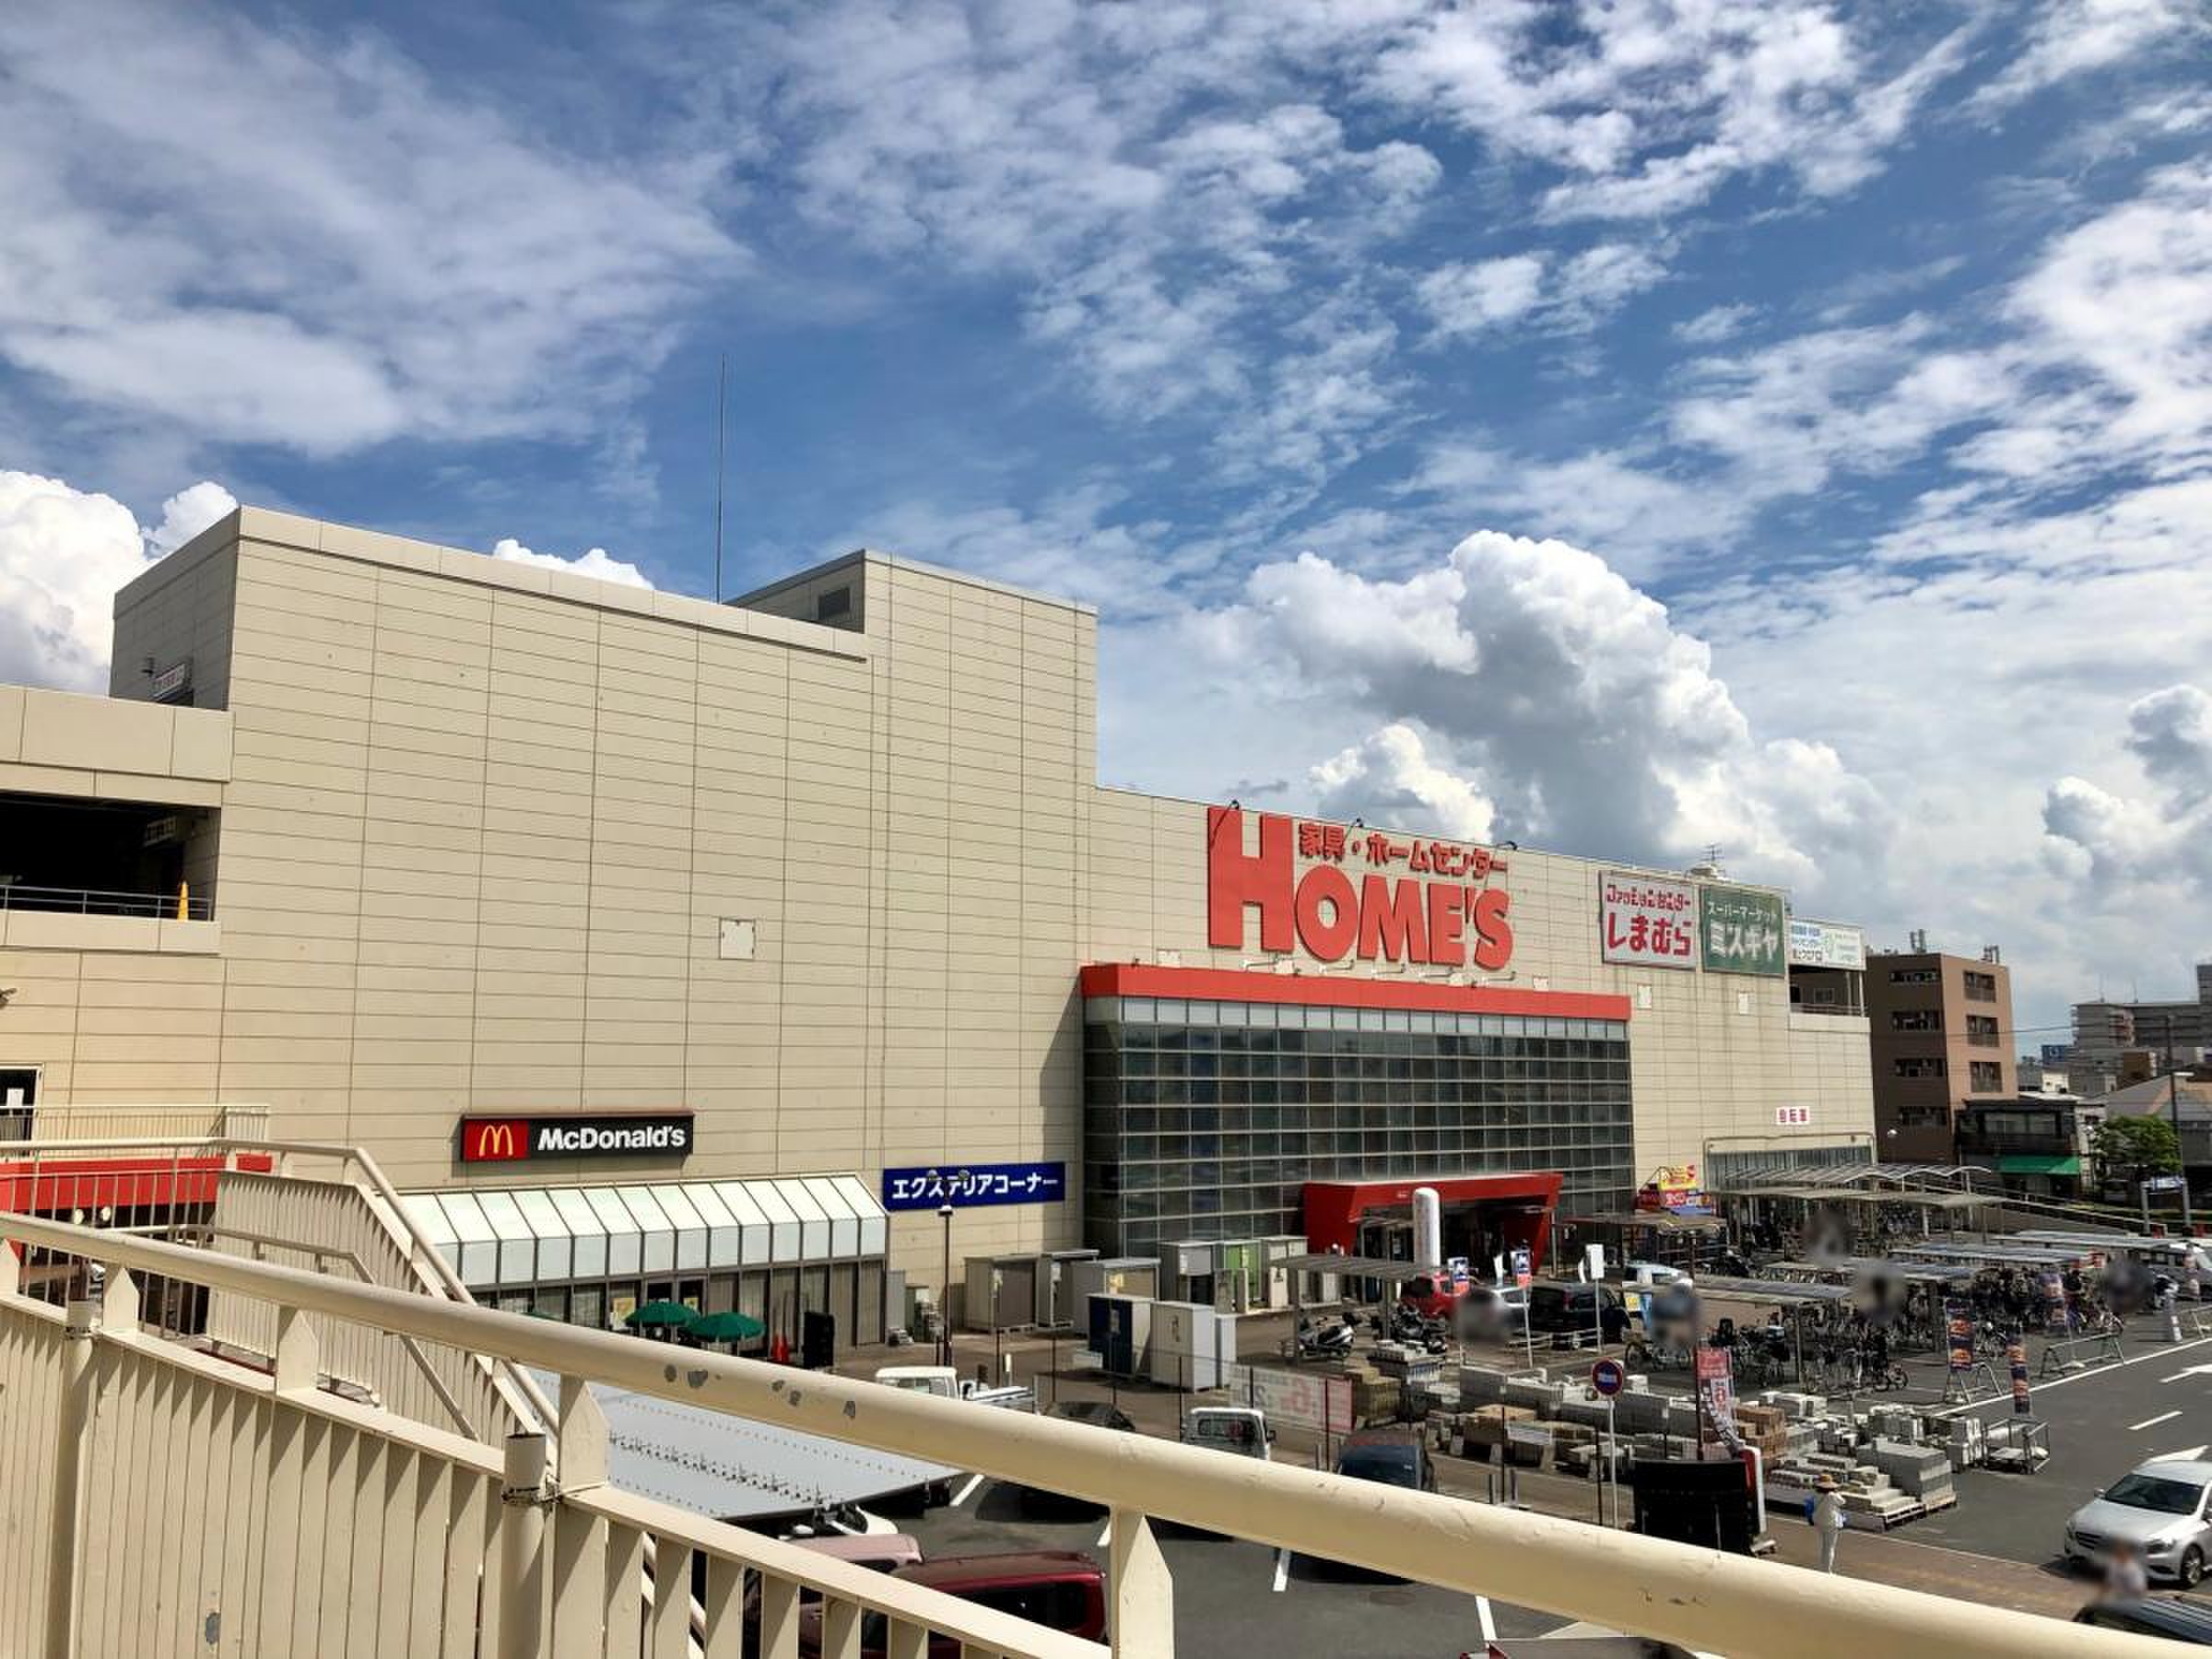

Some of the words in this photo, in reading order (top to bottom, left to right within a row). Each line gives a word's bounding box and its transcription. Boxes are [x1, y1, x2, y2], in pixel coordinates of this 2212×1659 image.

[1299, 823, 1507, 878] 家具・ホームセンター
[1207, 806, 1514, 971] HOME'S
[1607, 912, 1692, 957] しまむら
[537, 1125, 686, 1151] McDonald's
[891, 1171, 1059, 1199] エクステリアコーナー
